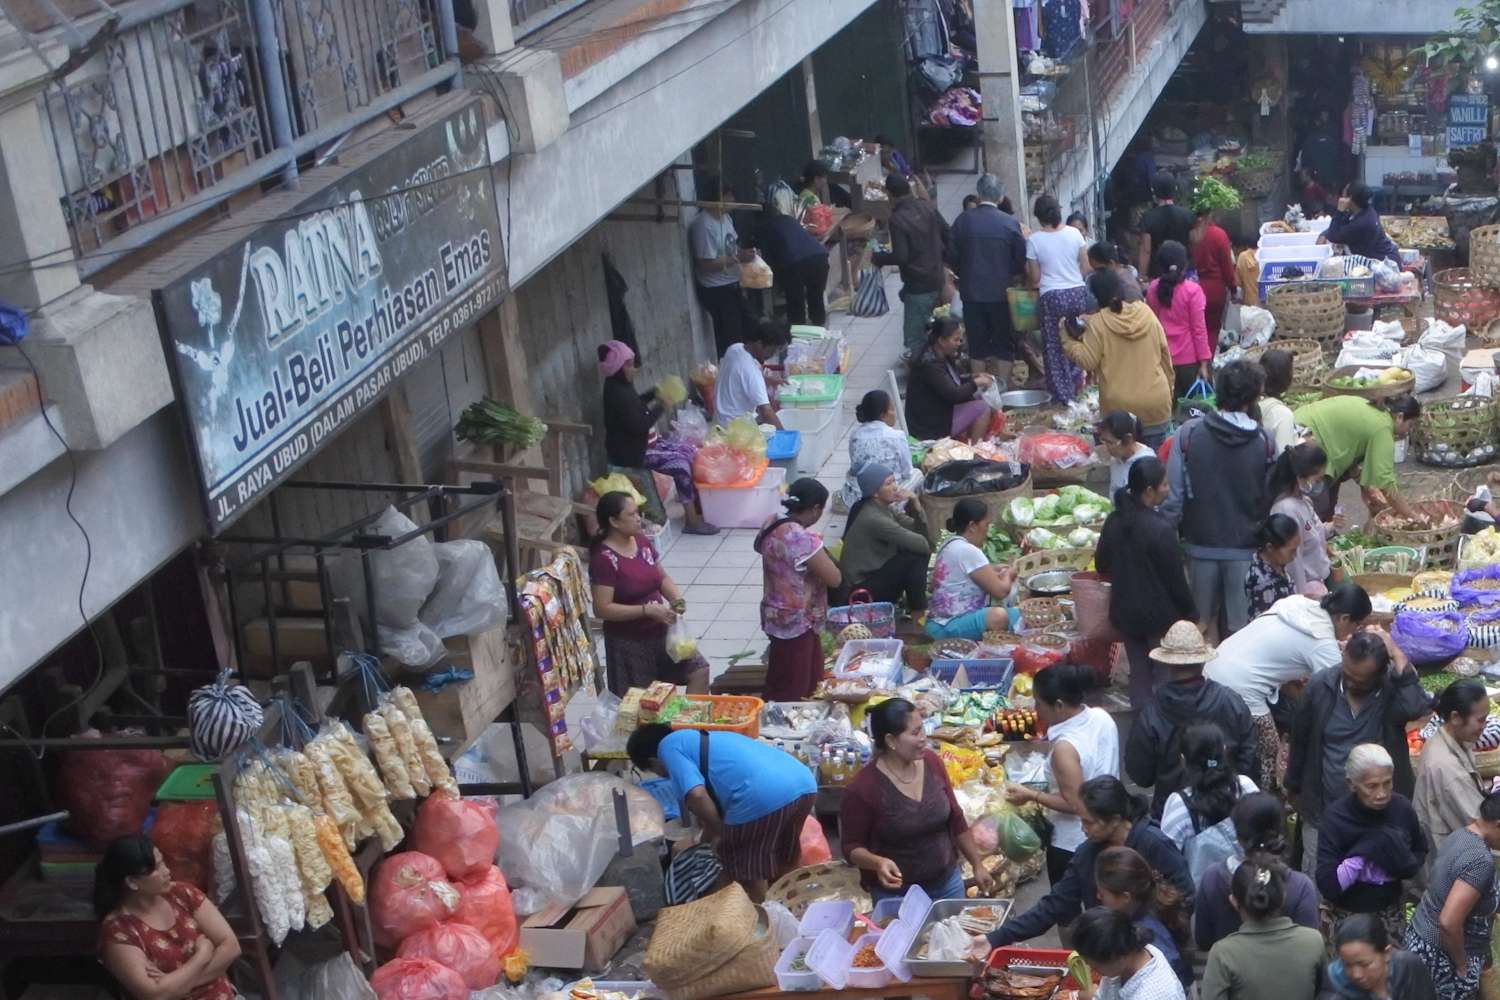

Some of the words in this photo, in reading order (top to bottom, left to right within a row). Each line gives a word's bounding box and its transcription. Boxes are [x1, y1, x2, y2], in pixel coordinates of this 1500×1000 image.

[233, 333, 336, 451] Jual-Beli
[337, 269, 440, 370] Perhiasan
[440, 230, 490, 292] Emas
[250, 189, 382, 350] RATNA
[217, 498, 236, 522] JL.
[237, 465, 272, 503] RAYA
[273, 437, 308, 473] UBUD
[310, 395, 355, 448] (DALAM
[355, 366, 391, 407] PASAR
